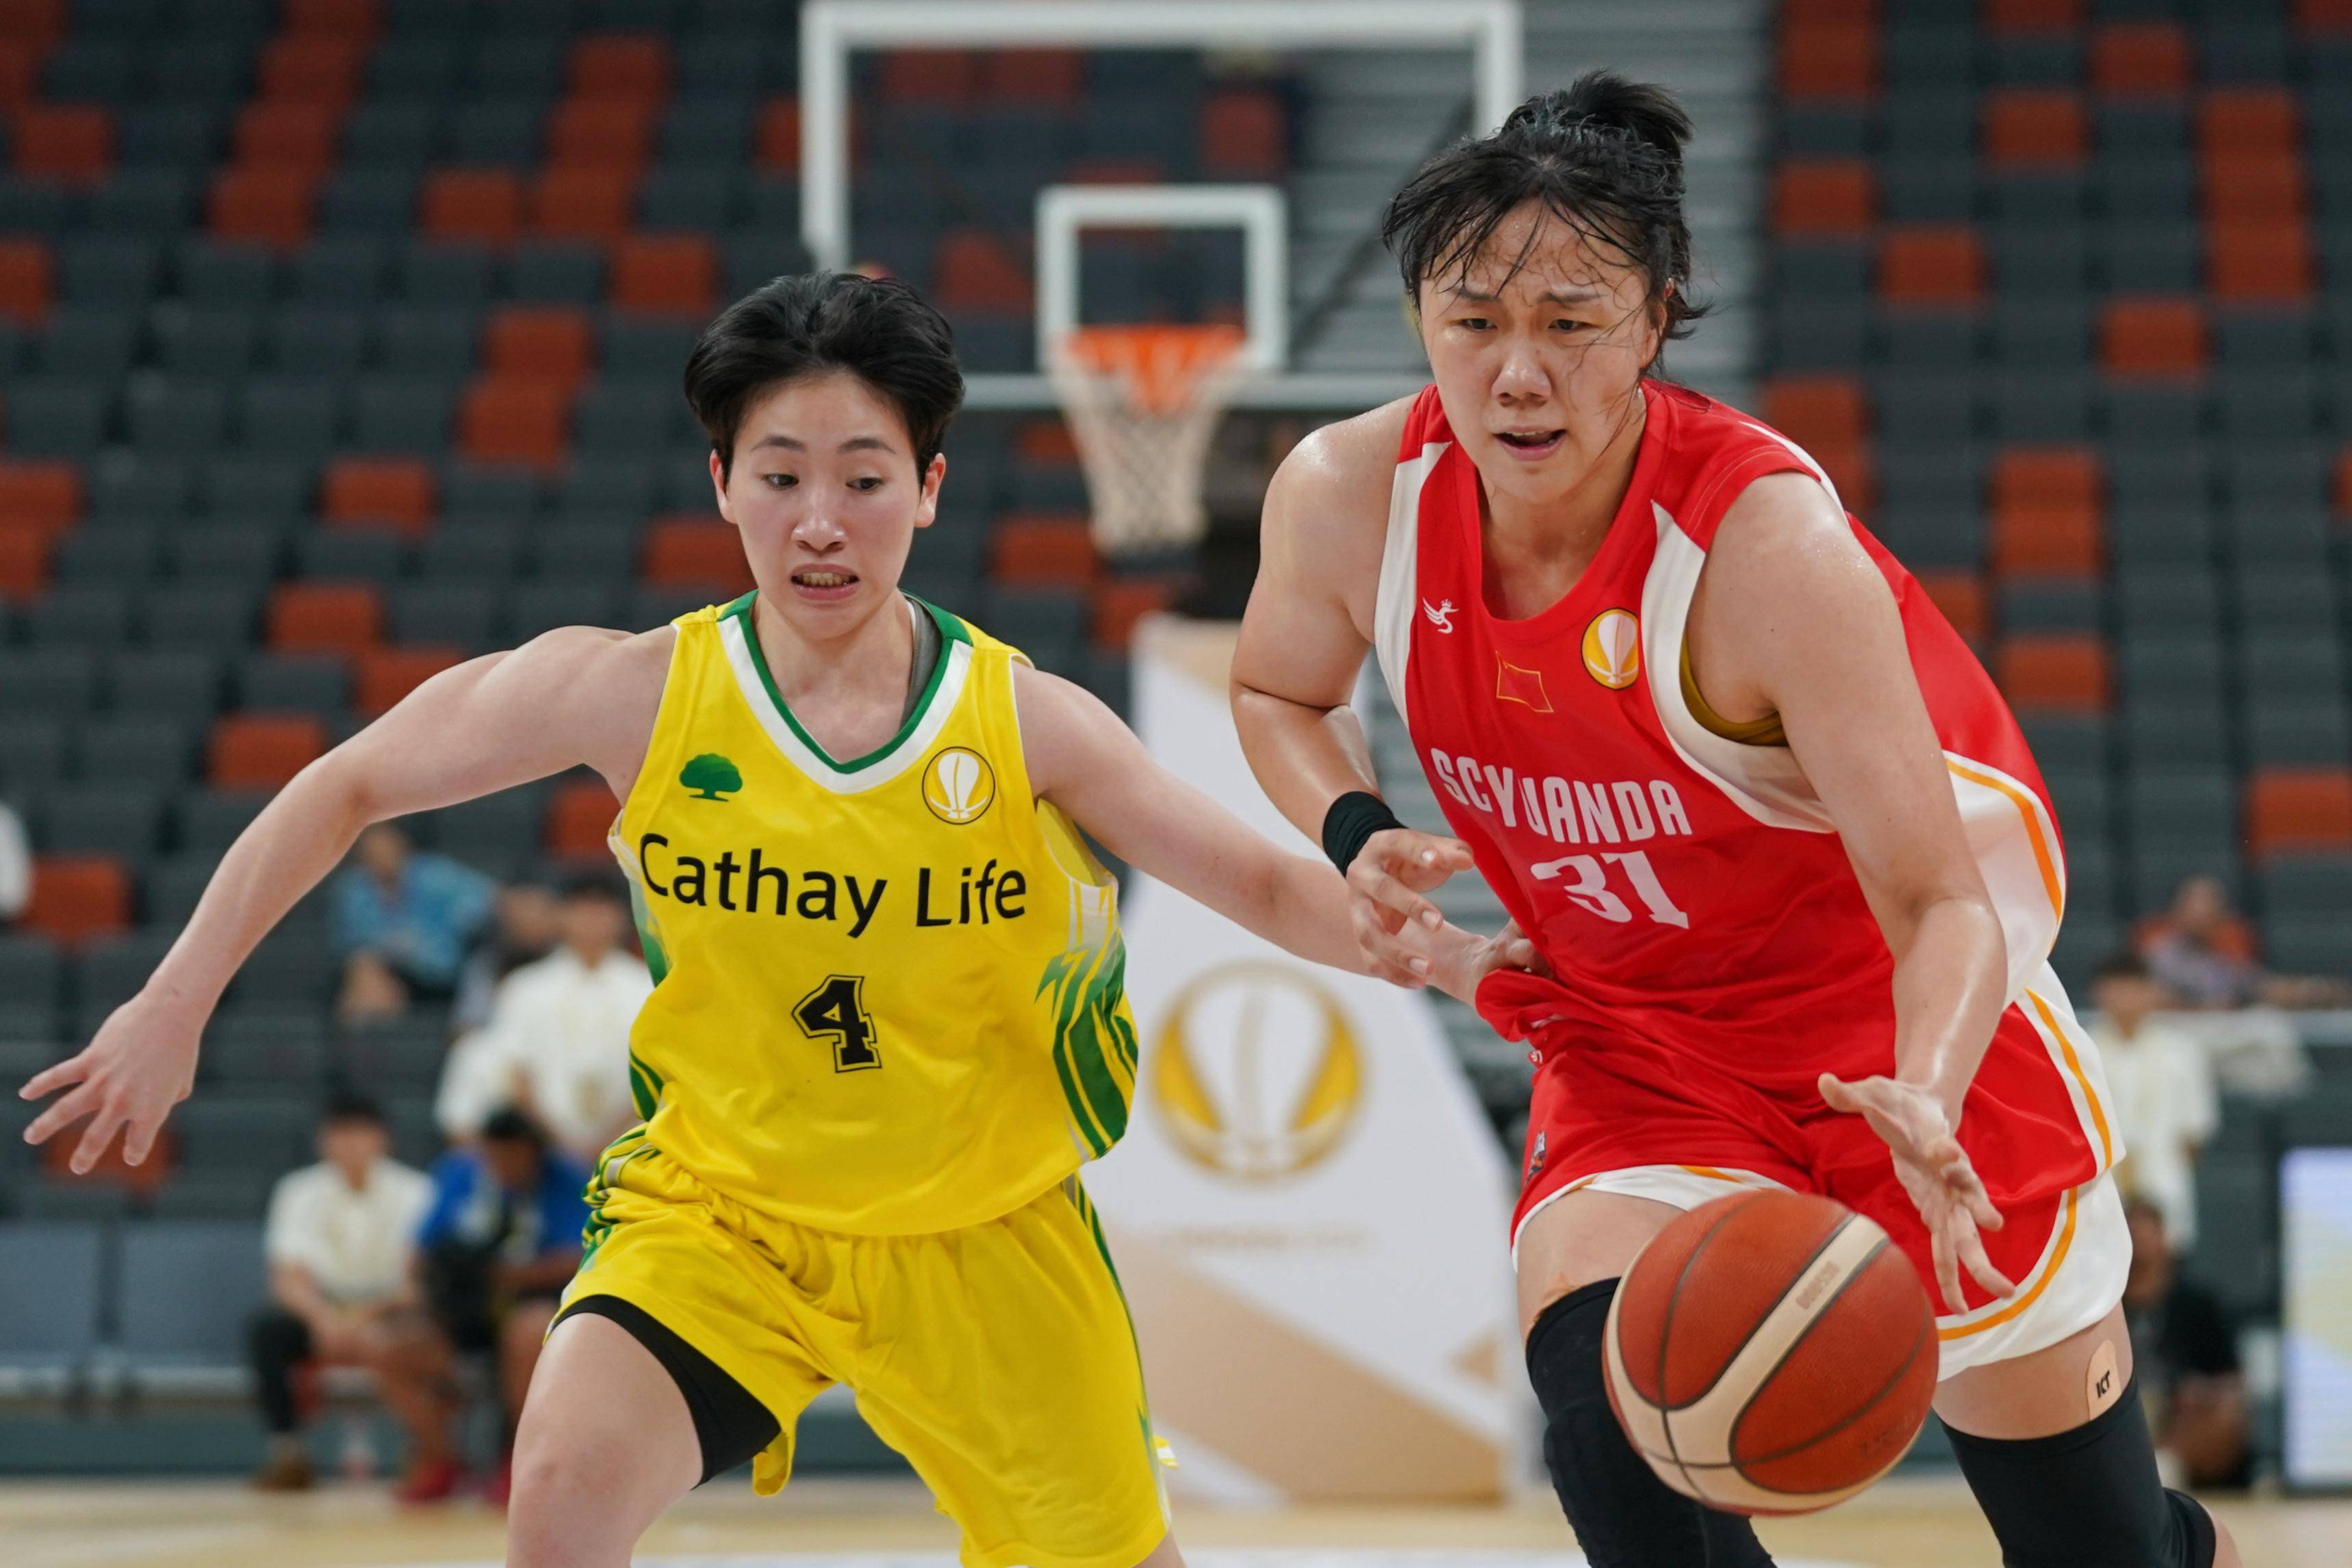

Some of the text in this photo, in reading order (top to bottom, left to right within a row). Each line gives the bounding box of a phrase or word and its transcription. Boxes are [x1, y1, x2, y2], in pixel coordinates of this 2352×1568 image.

[640, 833, 1026, 938] Cathay Life
[1531, 851, 1690, 929] 31
[792, 975, 882, 1073] 4
